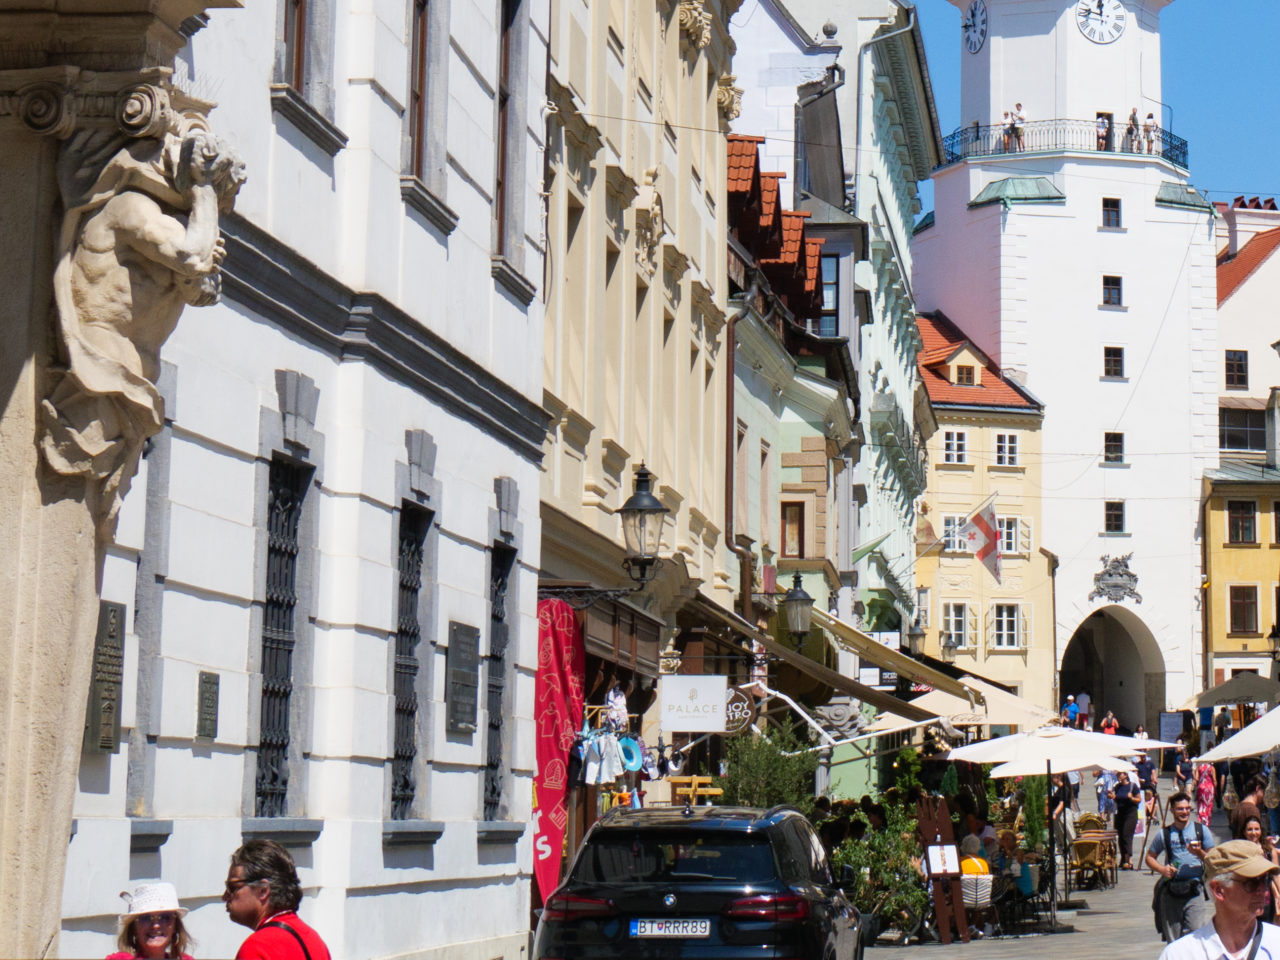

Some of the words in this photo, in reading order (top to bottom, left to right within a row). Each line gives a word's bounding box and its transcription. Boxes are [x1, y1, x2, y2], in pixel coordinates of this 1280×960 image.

[668, 704, 718, 713] PALACE
[726, 701, 749, 713] JOY
[726, 710, 752, 721] TRO
[639, 920, 656, 934] BT
[664, 920, 707, 934] RRR89
